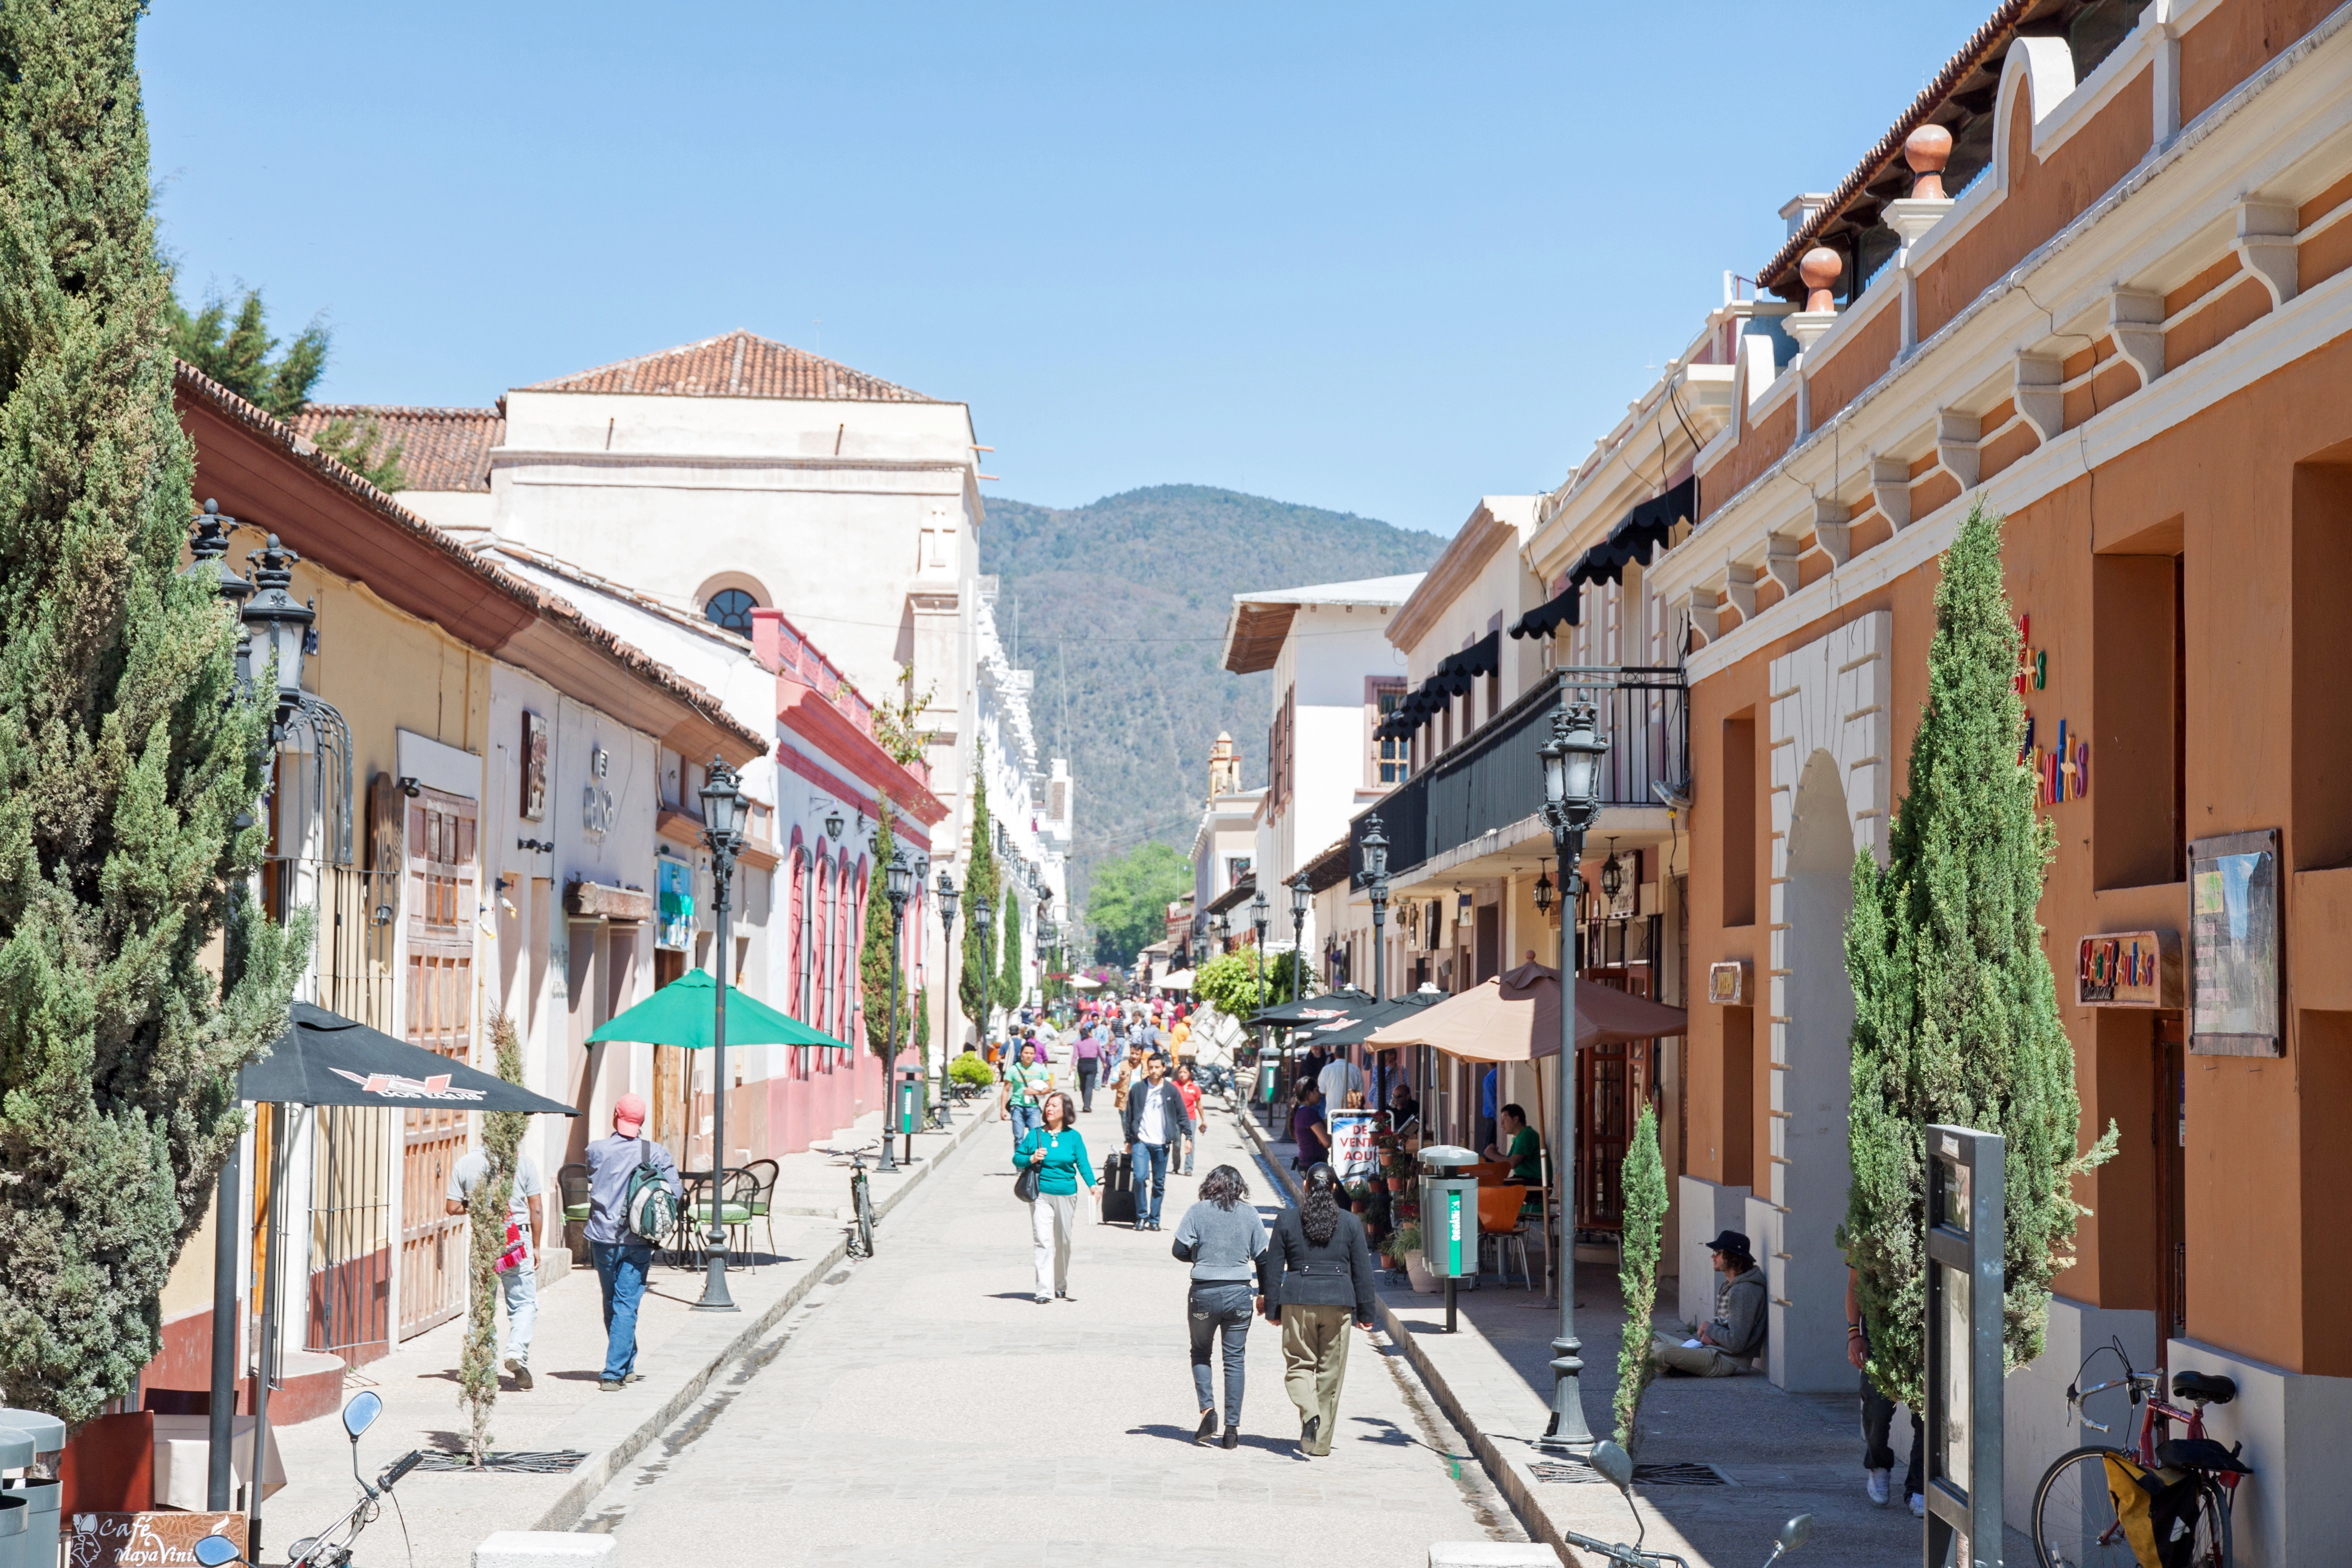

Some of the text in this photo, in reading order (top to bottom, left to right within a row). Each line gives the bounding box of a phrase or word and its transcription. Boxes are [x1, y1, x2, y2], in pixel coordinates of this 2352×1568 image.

[2017, 709, 2088, 809] lautas
[2082, 940, 2154, 986] Las Flautas
[376, 1090, 483, 1100] DOS EQUIS
[1353, 1125, 1368, 1134] DE
[1340, 1138, 1376, 1148] VENT
[100, 1516, 153, 1549] Café
